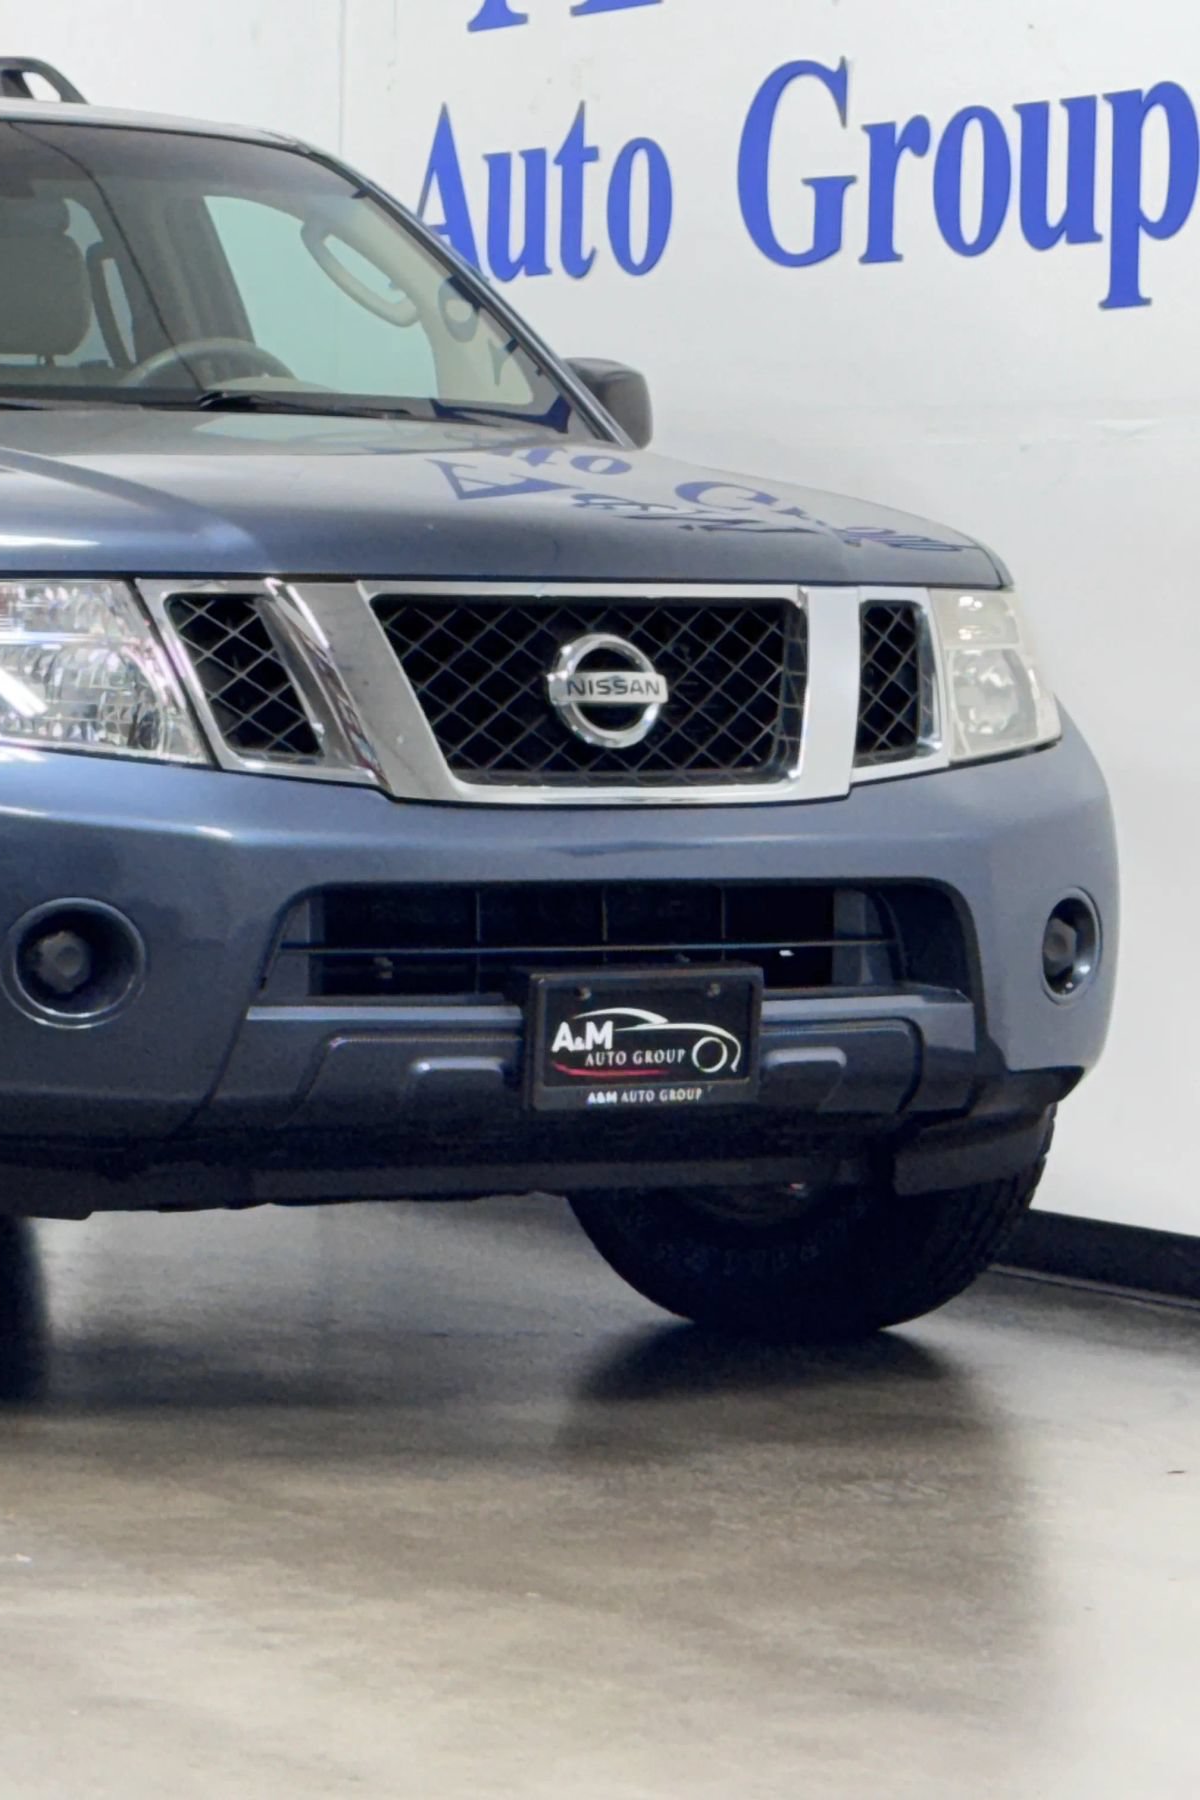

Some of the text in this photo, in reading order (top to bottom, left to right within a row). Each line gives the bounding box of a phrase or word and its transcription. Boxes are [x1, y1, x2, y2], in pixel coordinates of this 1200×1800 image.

[415, 56, 1200, 310] Auto Group
[567, 679, 660, 696] NISSAN
[551, 1020, 614, 1052] A&M
[584, 1048, 686, 1067] AUTO GROUP
[621, 1090, 656, 1103] AUTO
[659, 1087, 702, 1101] GROUP
